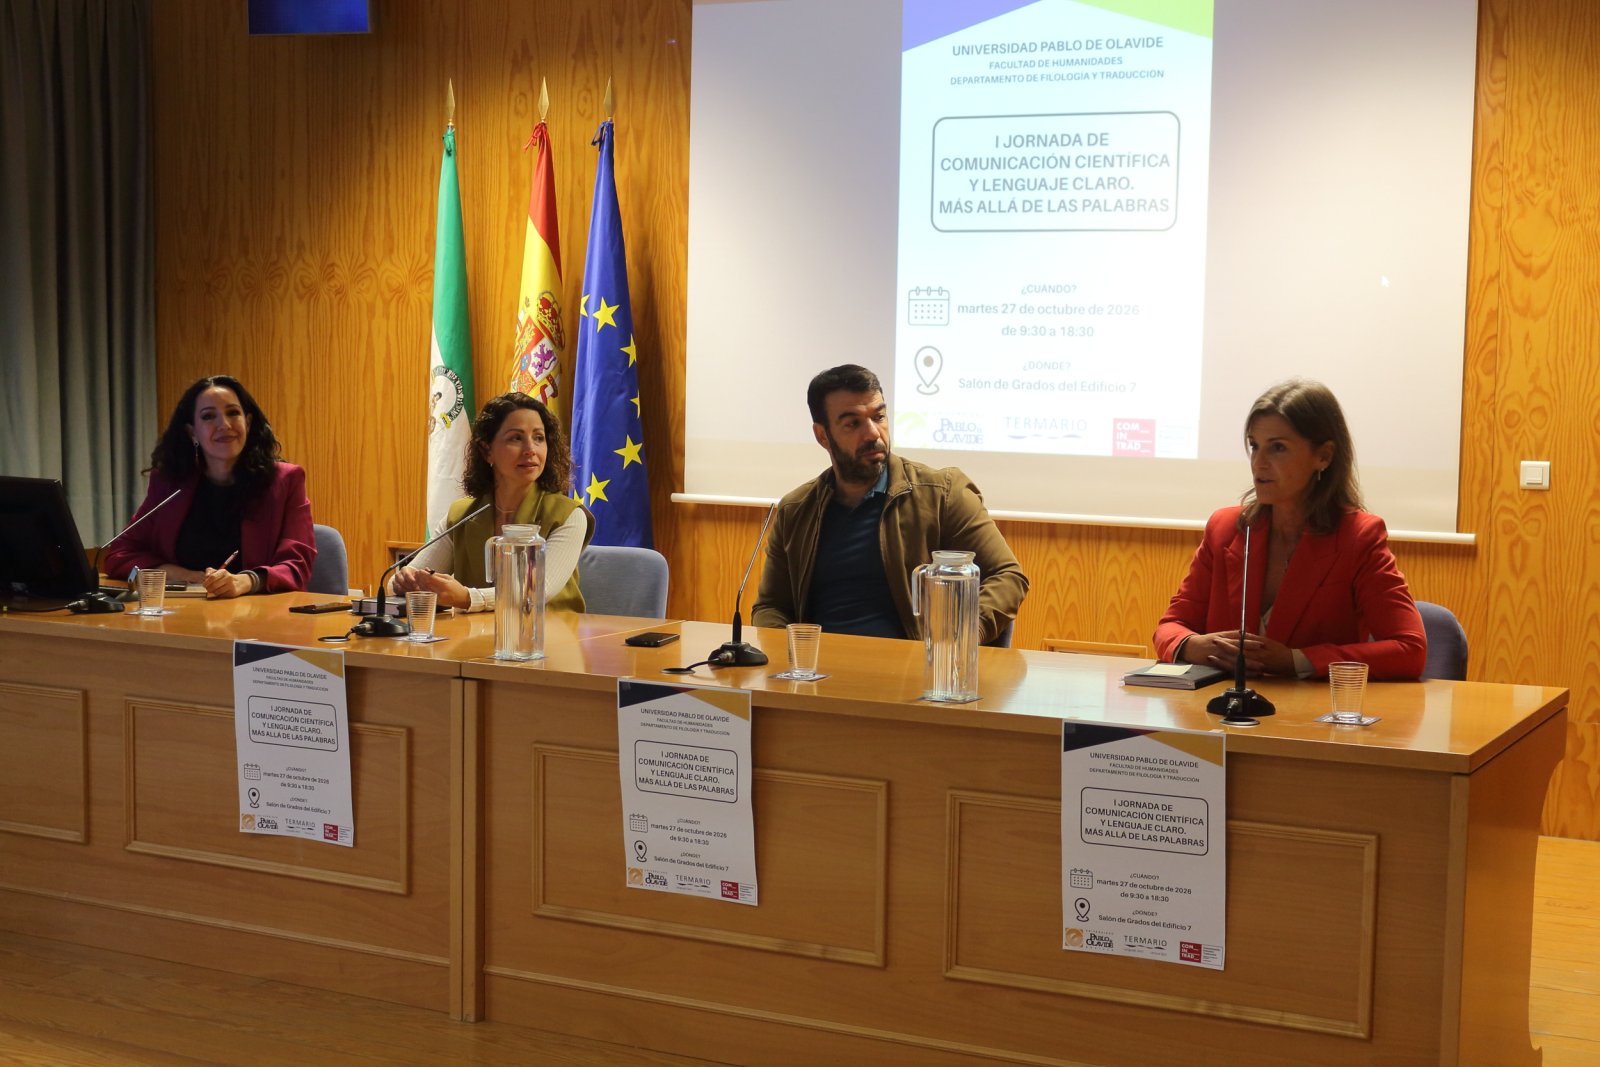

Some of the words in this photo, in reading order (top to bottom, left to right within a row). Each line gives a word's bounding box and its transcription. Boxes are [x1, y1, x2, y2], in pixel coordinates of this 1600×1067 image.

[952, 43, 1037, 56] UNIVERSIDAD
[1040, 40, 1083, 52] PABLO
[1086, 39, 1103, 50] DE
[1105, 36, 1164, 50] OLAVIDE
[989, 60, 1036, 70] FACULTAD
[1038, 59, 1050, 68] DE
[1052, 56, 1123, 67] HUMANIDADES
[950, 74, 1024, 85] DEPARTAMENTO
[1026, 73, 1038, 82] DE
[995, 135, 999, 148] I
[1003, 133, 1083, 148] JORNADA
[1087, 133, 1109, 146] DE
[940, 153, 1071, 170] COMUNICACIÓN
[1075, 151, 1170, 169] CIENTÍFICA
[970, 179, 978, 191] Y
[982, 177, 1069, 191] LENGUAJE
[1072, 176, 1134, 190] CLARO.
[939, 198, 973, 214] MÁS
[977, 197, 1017, 213] ALLÁ
[1022, 200, 1044, 213] DE
[1047, 199, 1078, 213] LAS
[1082, 198, 1169, 212] PALABRAS
[957, 304, 999, 314] martes
[1001, 303, 1016, 314] 27
[1019, 303, 1035, 314] de
[1037, 304, 1085, 314] octubre
[1088, 304, 1104, 315] de
[1107, 304, 1140, 315] 2026
[1001, 325, 1017, 336] de
[1020, 325, 1046, 336] 9:30
[1049, 328, 1056, 336] a
[1060, 326, 1094, 337] 18:30
[994, 378, 1009, 389] de
[1011, 379, 1055, 390] Grados
[1057, 380, 1077, 391] del
[1080, 380, 1127, 392] Edificio
[1129, 382, 1136, 392] 7
[1004, 416, 1087, 431] TERMARIO
[253, 667, 283, 675] UNIVERSIDAD
[274, 706, 303, 715] JORNADA
[641, 708, 677, 717] UNIVERSIDAD
[267, 722, 299, 731] LENGUAJE
[304, 735, 335, 744] PALABRAS
[665, 752, 698, 761] JORNADA
[700, 755, 709, 763] DE
[1090, 752, 1135, 761] UNIVERSIDAD
[1170, 759, 1199, 768] OLAVIDE
[638, 757, 694, 770] COMUNICACIÓN
[695, 764, 734, 776] CIENTÍFICA
[1089, 768, 1128, 776] DEPARTAMENTO
[1142, 766, 1178, 774] HUMANIDADES
[657, 770, 693, 780] LENGUAJE
[694, 774, 720, 784] CLARO.
[673, 781, 683, 789] DE
[698, 784, 735, 795] PALABRAS
[1118, 800, 1159, 810] JORNADA
[1161, 804, 1173, 812] DE
[1085, 806, 1153, 820] COMUNICACIÓN
[1155, 813, 1204, 826] CIENTÍFICA
[1108, 820, 1152, 831] LENGUAJE
[1154, 824, 1186, 835] CLARO.
[1128, 832, 1140, 840] DE
[1141, 834, 1158, 842] LAS
[1160, 835, 1204, 847] PALABRAS
[1138, 883, 1164, 891] octubre
[1130, 892, 1144, 900] 9:30
[1127, 917, 1150, 926] Grados
[1162, 922, 1186, 930] Edificio
[1124, 936, 1167, 947] TERMARIO
